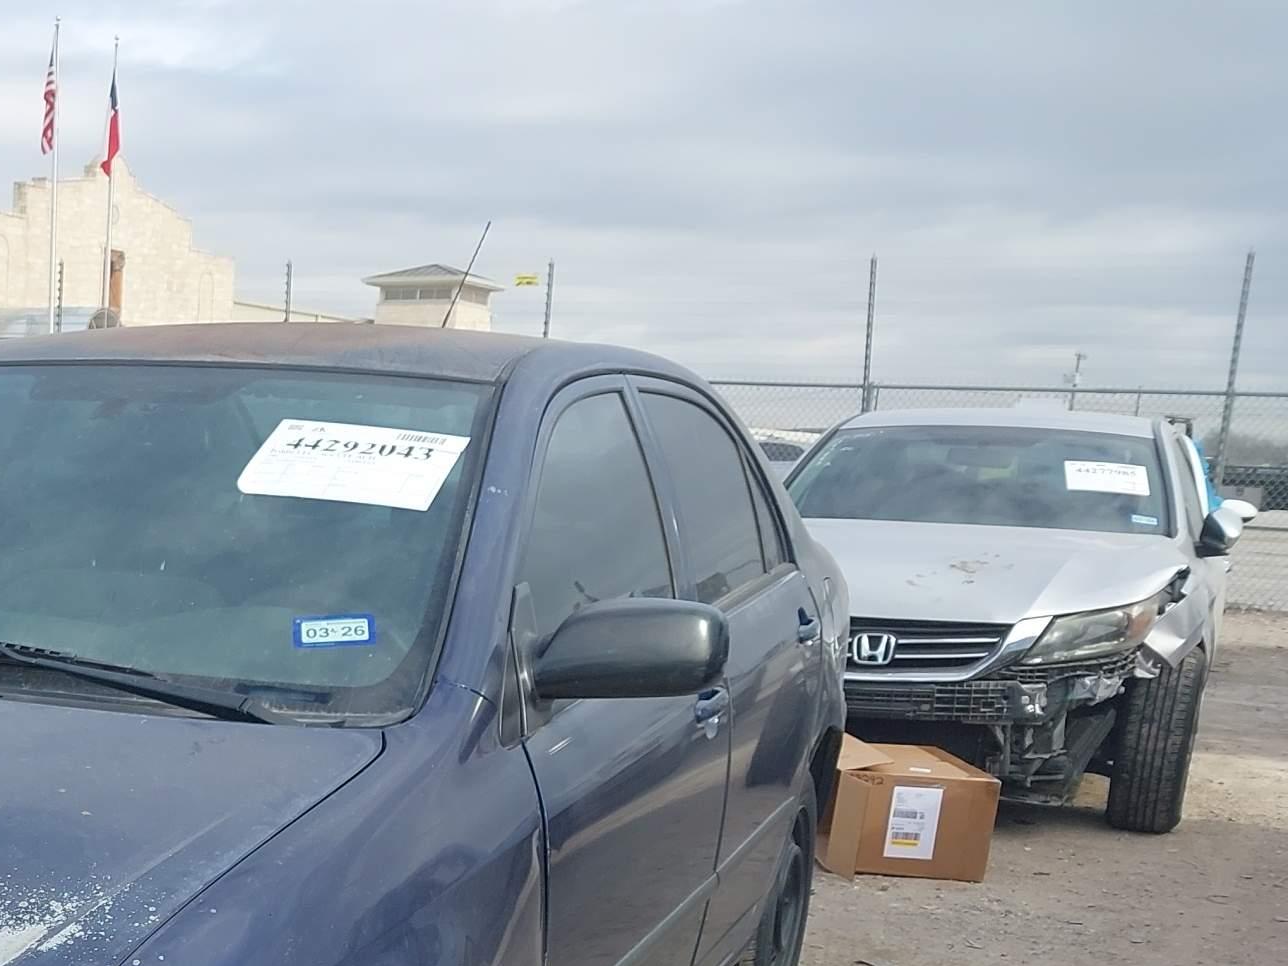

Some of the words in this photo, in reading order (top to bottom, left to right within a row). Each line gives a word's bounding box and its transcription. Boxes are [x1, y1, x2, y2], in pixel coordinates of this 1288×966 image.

[286, 436, 435, 461] 44292043
[305, 627, 330, 639] 03
[341, 625, 366, 637] 26
